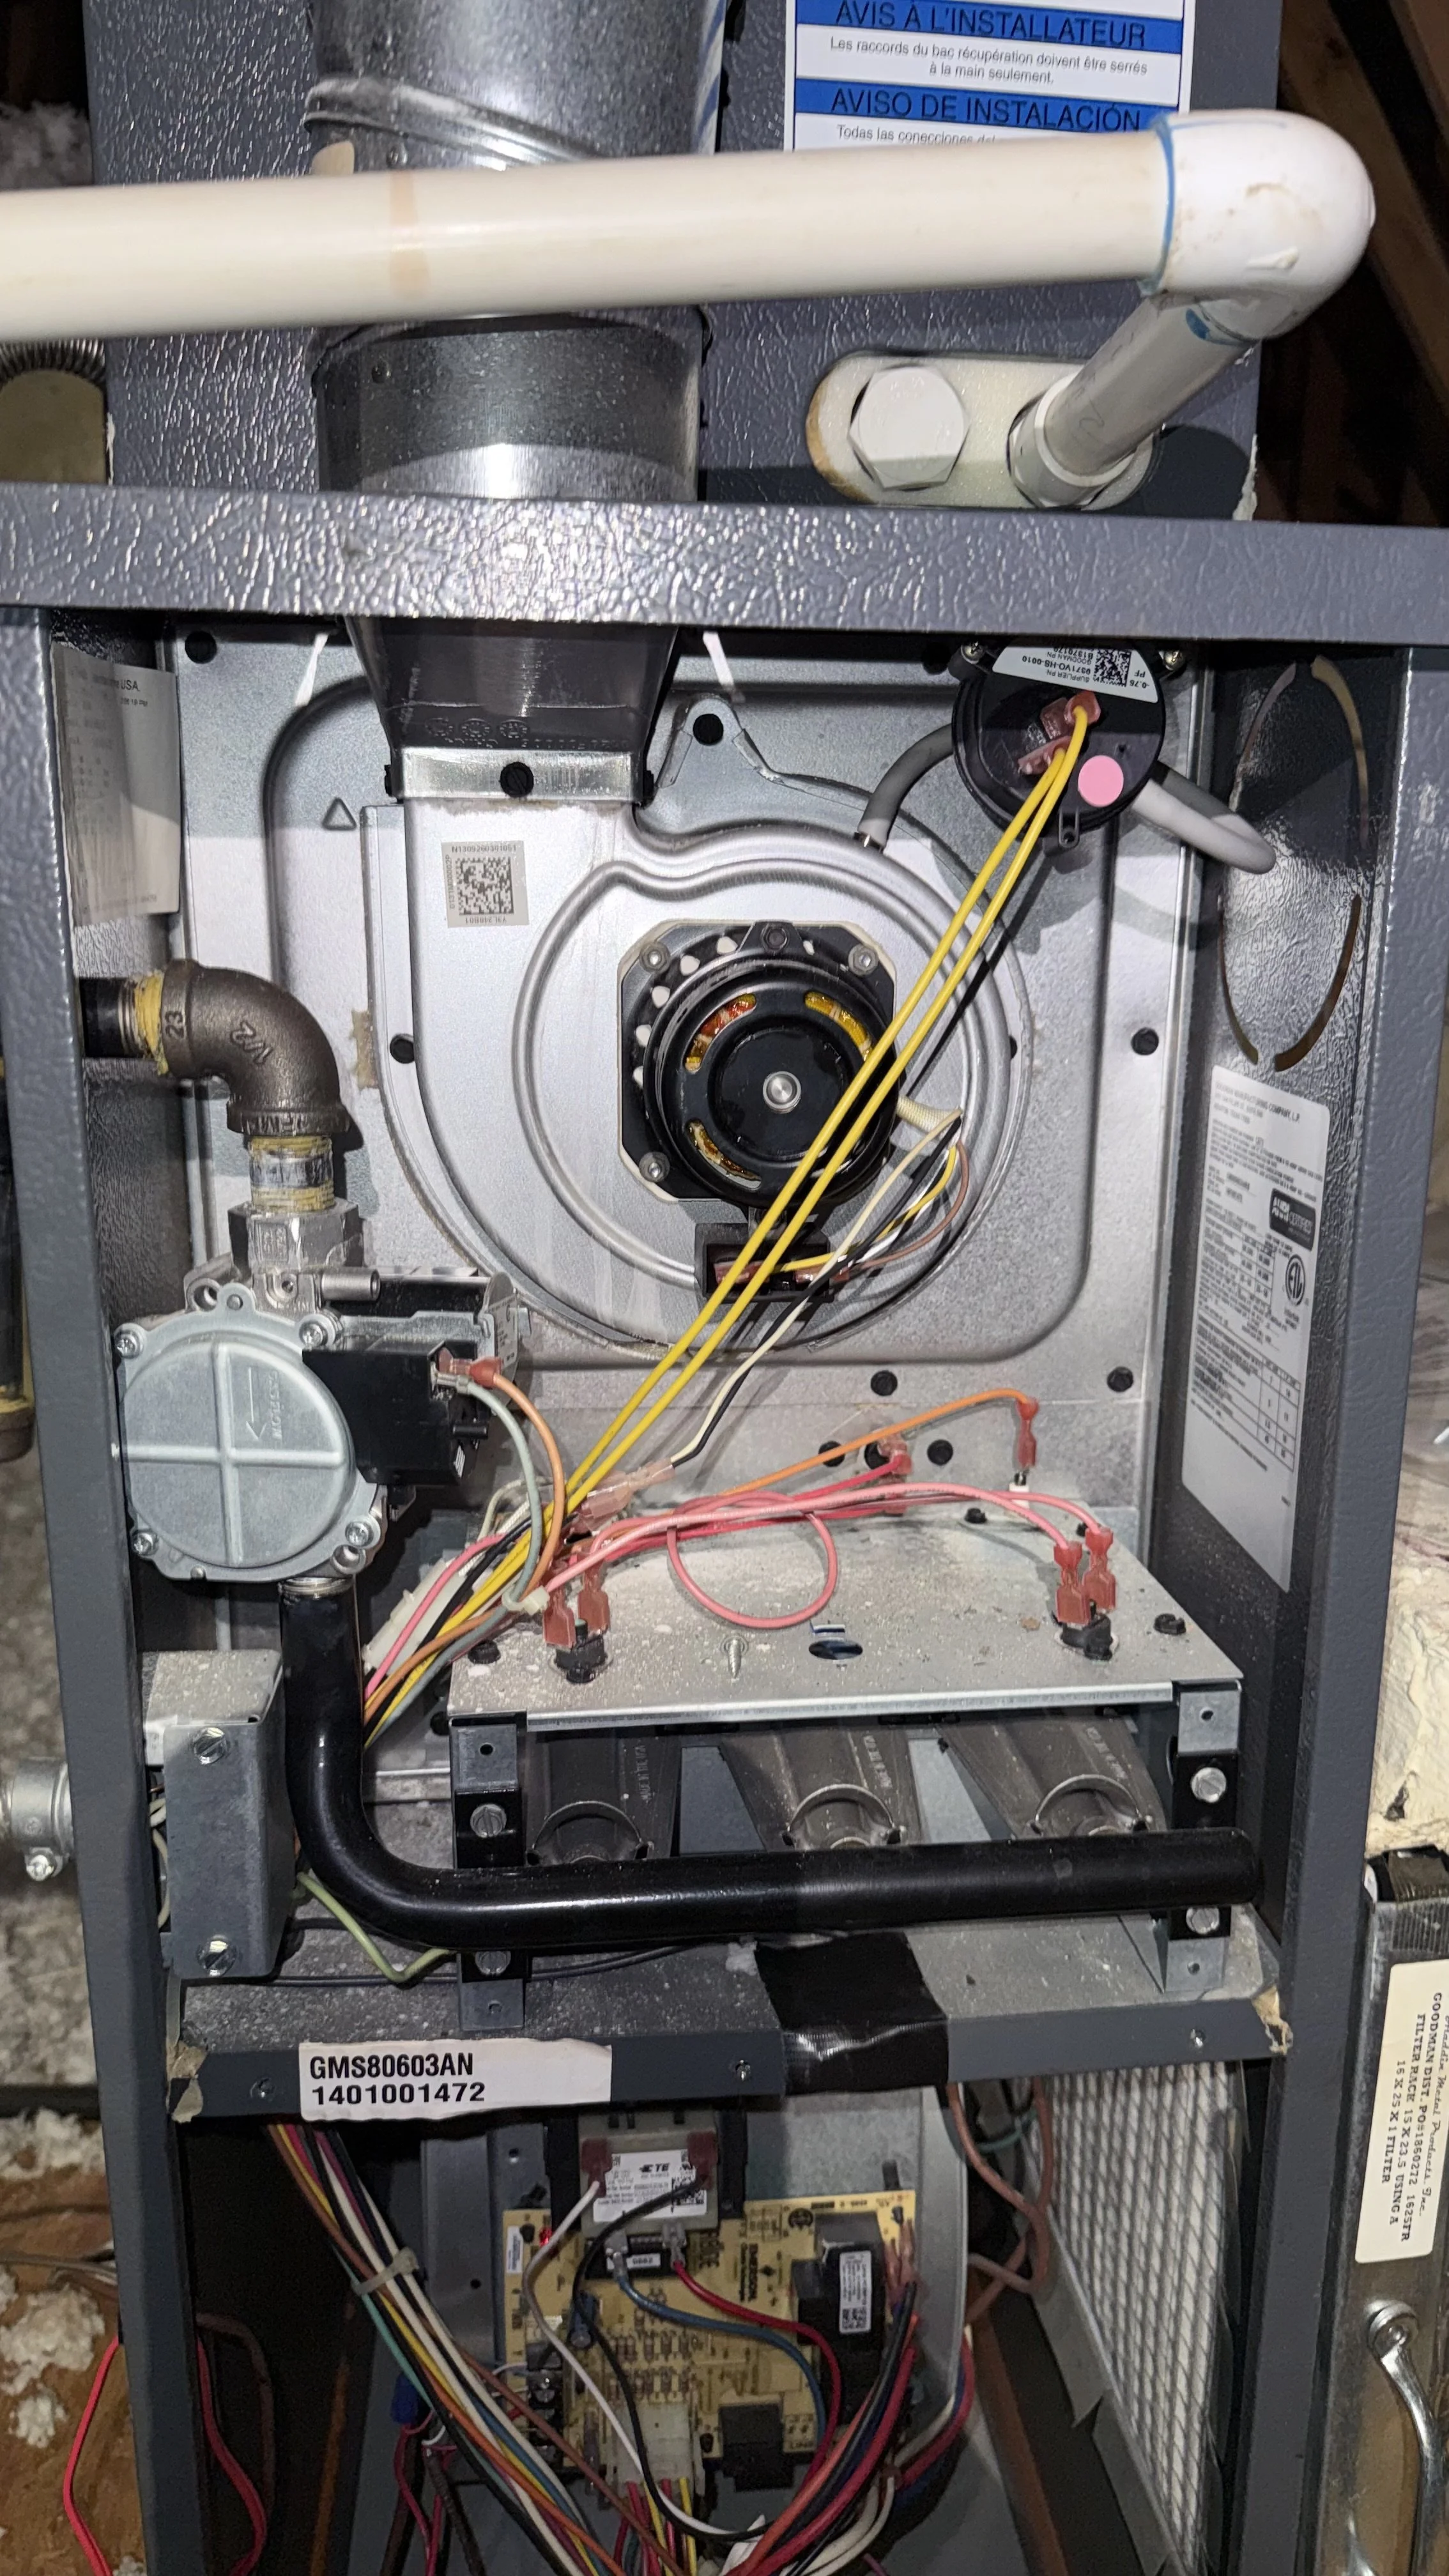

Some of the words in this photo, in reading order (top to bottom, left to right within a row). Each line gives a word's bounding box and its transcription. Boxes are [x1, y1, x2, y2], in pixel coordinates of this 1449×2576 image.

[835, 0, 896, 27] AVIS
[931, 6, 1146, 48] L'INSTALLATEUR
[830, 36, 853, 53] Les
[857, 38, 909, 56] raccords
[912, 42, 928, 58] du
[931, 44, 954, 60] bac
[958, 45, 1033, 67] récupération
[1036, 50, 1080, 69] doivent
[1083, 54, 1107, 72] être
[1110, 57, 1148, 75] serrés
[929, 62, 938, 76] à
[940, 63, 951, 77] la
[955, 65, 985, 79] main
[831, 88, 912, 118] AVISO
[921, 94, 957, 121] DE
[966, 96, 1142, 132] INSTALACIÓN
[837, 124, 873, 140] Todas
[877, 126, 894, 141] las
[1057, 671, 1090, 683] SUPPLIER
[1133, 670, 1146, 678] PF
[164, 1011, 185, 1039] 23
[1411, 2012, 1426, 2063] FILTER
[1425, 1992, 1443, 2064] GOODMAN
[310, 2051, 473, 2080] GMS80603AN
[1396, 2060, 1406, 2076] 16
[312, 2082, 486, 2106] 1401001472
[1393, 2077, 1404, 2090] X
[1406, 2066, 1419, 2103] RACK
[1420, 2066, 1432, 2102] DIST.
[1432, 2074, 1447, 2117] Metal
[1392, 2092, 1402, 2108] 25
[1389, 2110, 1400, 2122] X
[1403, 2109, 1413, 2124] 15
[1400, 2126, 1411, 2139] X
[1381, 2136, 1396, 2184] FILTER
[1397, 2140, 1409, 2169] 23.5
[1391, 2173, 1405, 2213] USING
[1418, 2187, 1432, 2216] Inc.
[1389, 2216, 1399, 2226] A
[1400, 2194, 1416, 2242] 1625FR
